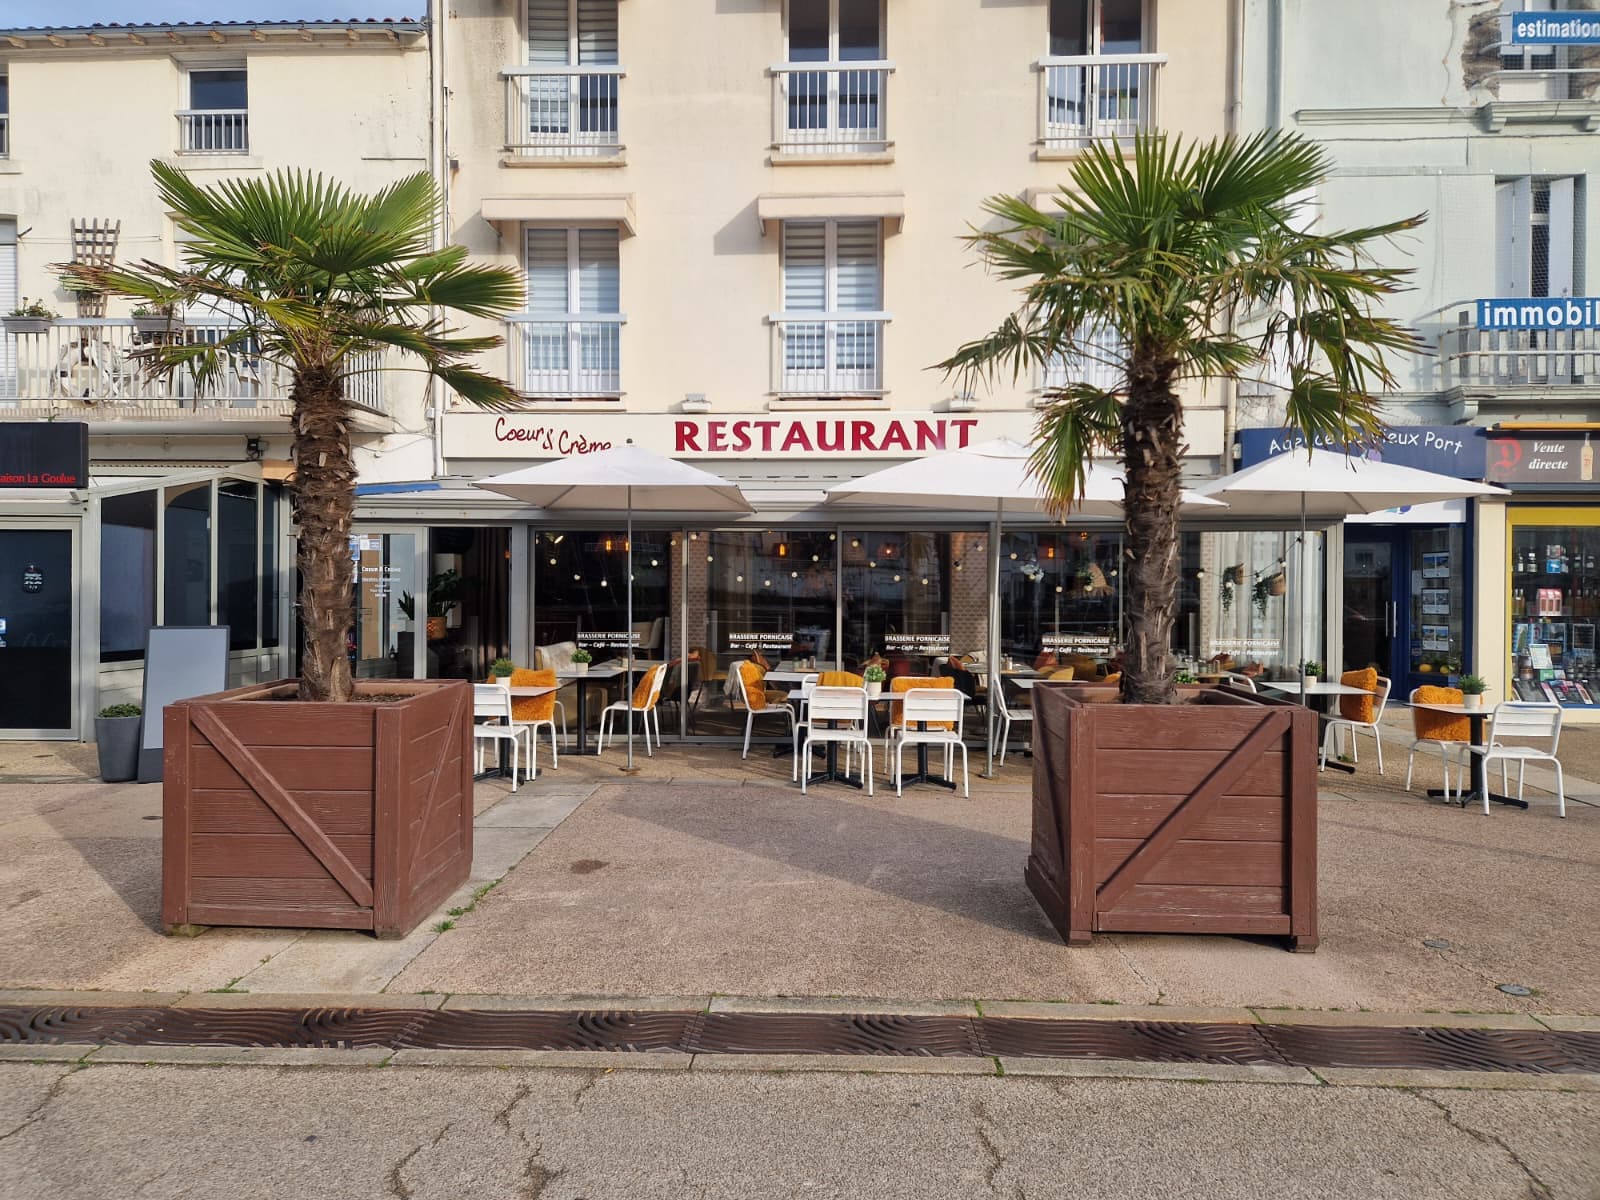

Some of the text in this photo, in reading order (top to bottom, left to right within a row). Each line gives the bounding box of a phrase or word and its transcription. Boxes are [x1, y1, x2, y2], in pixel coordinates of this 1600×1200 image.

[1484, 300, 1600, 326] immobil
[495, 416, 545, 442] Coeur
[674, 419, 979, 451] RESTAURANT
[1424, 431, 1464, 455] Port
[1533, 441, 1566, 453] Vente
[1528, 458, 1569, 470] directe
[27, 473, 39, 483] La
[41, 473, 76, 483] Goulue
